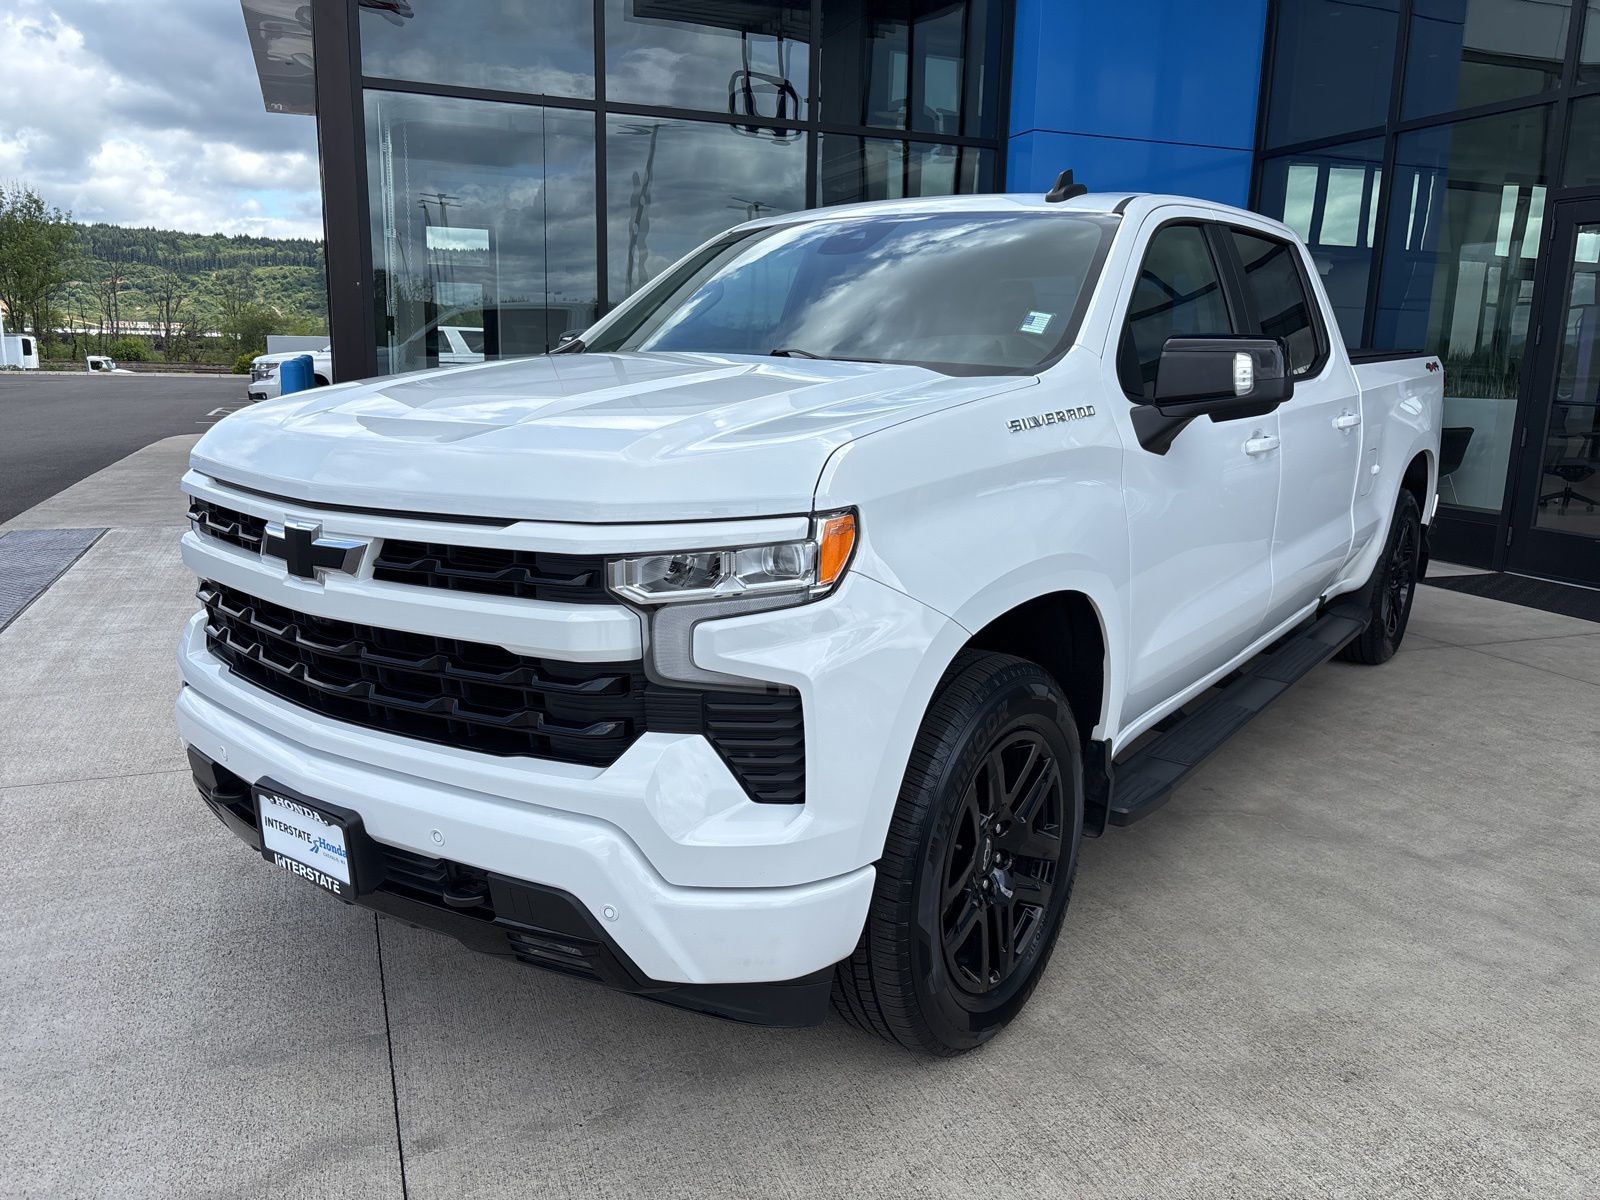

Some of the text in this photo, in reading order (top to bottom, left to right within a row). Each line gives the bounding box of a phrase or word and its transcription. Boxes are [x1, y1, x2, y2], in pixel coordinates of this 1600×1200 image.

[1006, 405, 1096, 433] SILVERADO
[273, 796, 323, 822] HONDA
[264, 815, 313, 844] INTERSTATE
[318, 835, 348, 858] Honda
[273, 852, 341, 895] INTERSTATE
